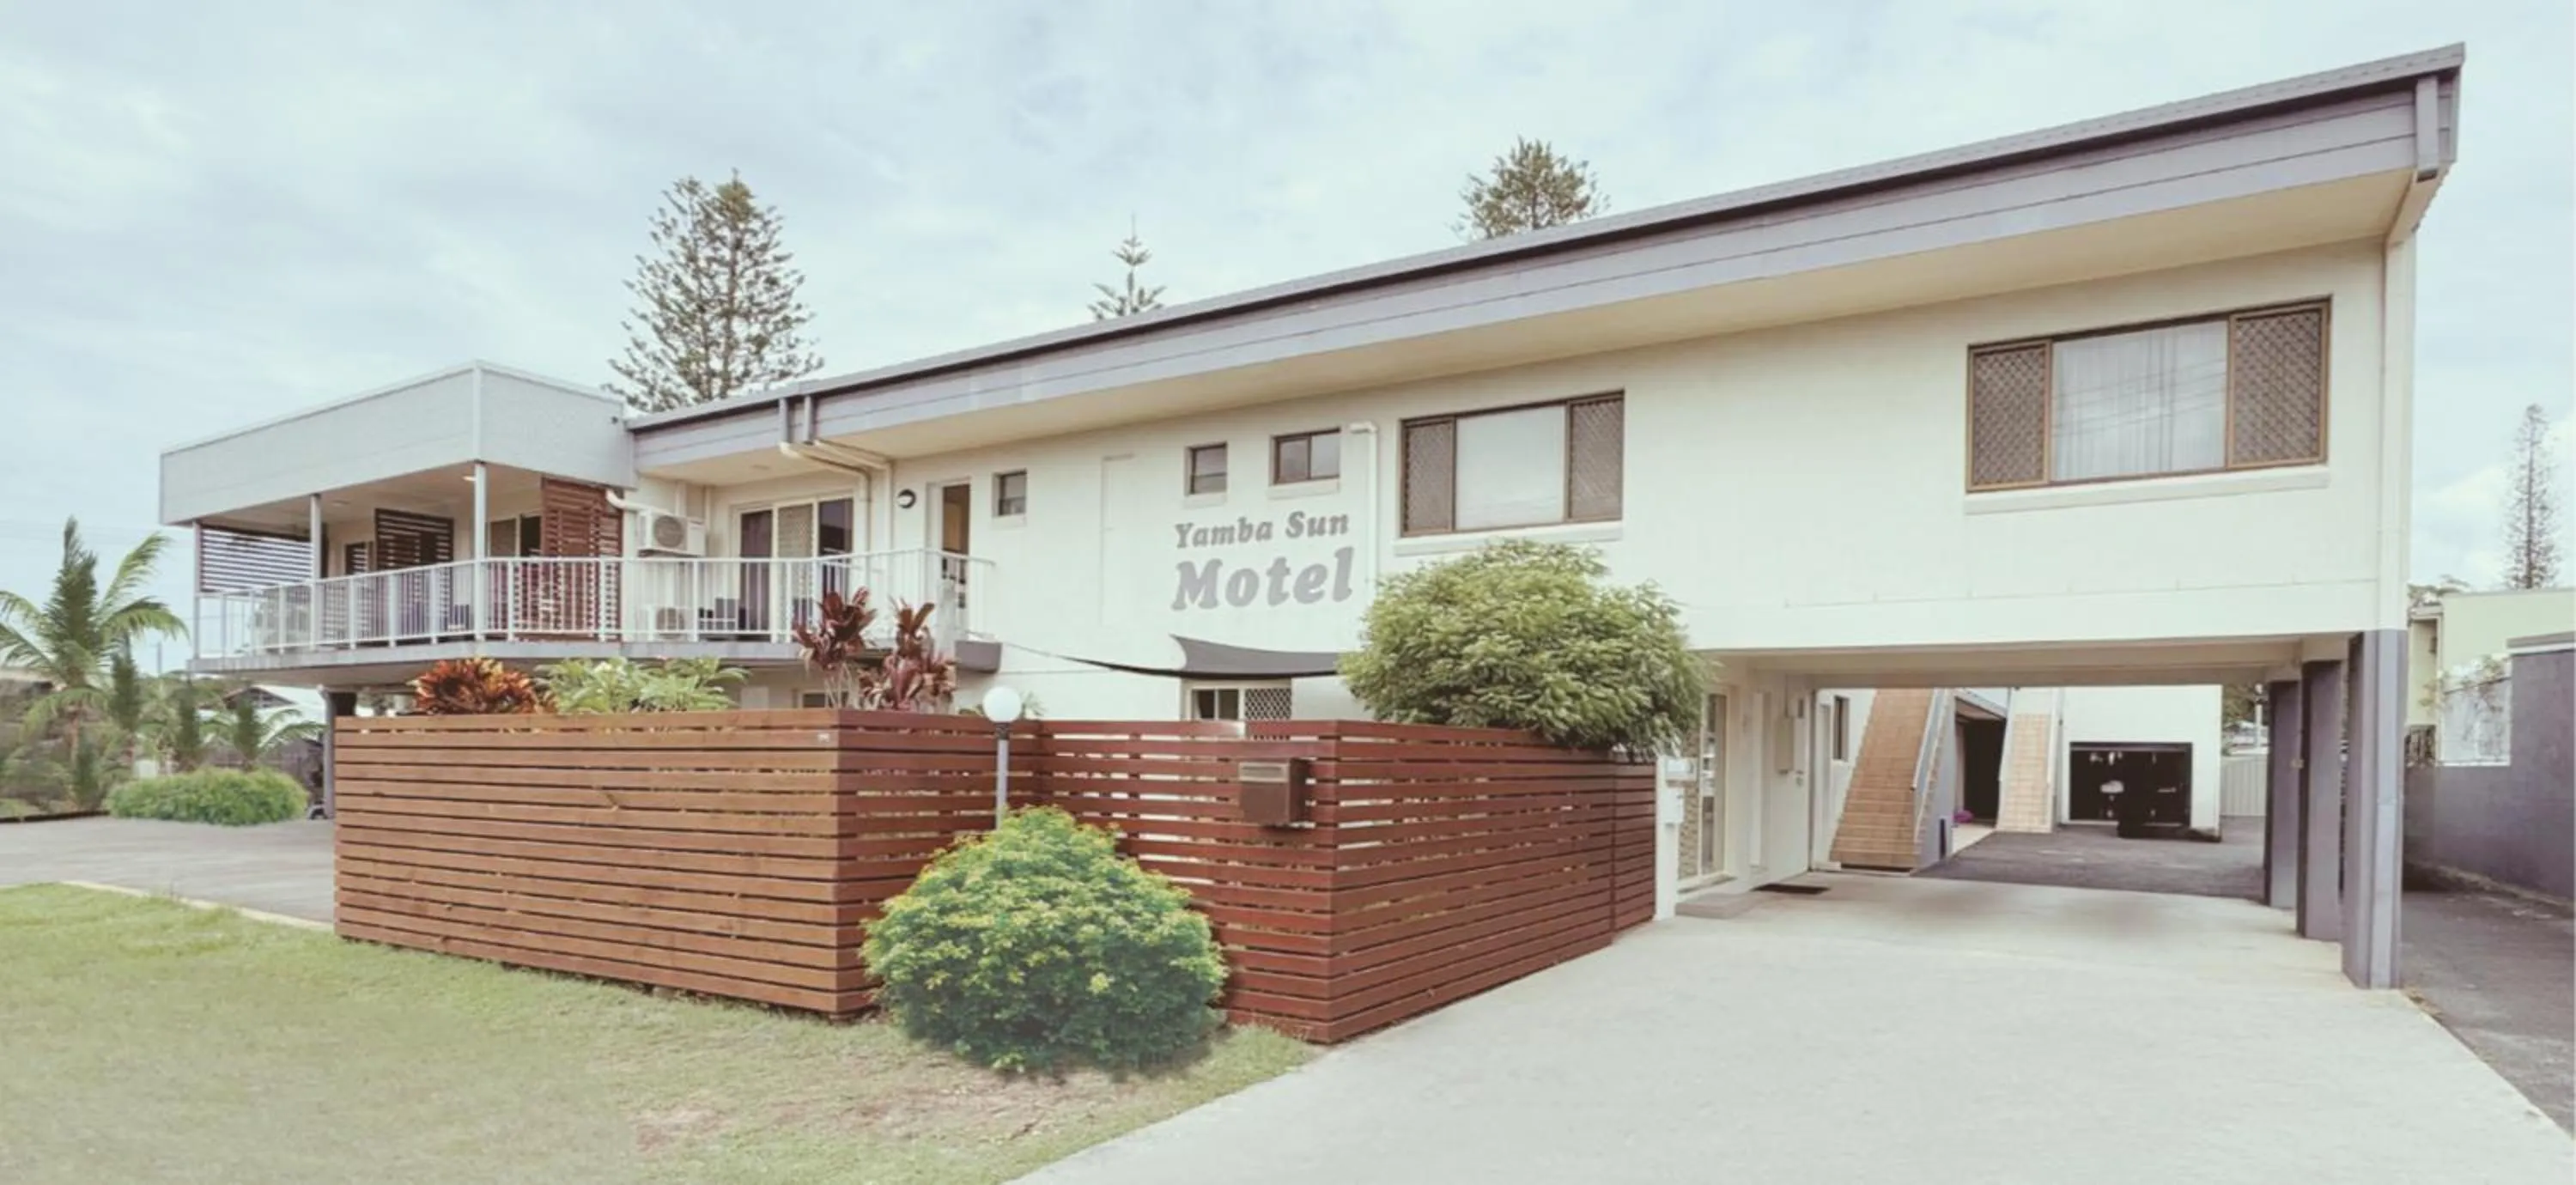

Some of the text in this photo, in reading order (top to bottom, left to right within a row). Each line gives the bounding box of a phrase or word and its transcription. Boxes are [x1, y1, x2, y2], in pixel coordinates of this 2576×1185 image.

[1175, 511, 1349, 549] Yamba Sun
[1170, 546, 1355, 611] Motel
